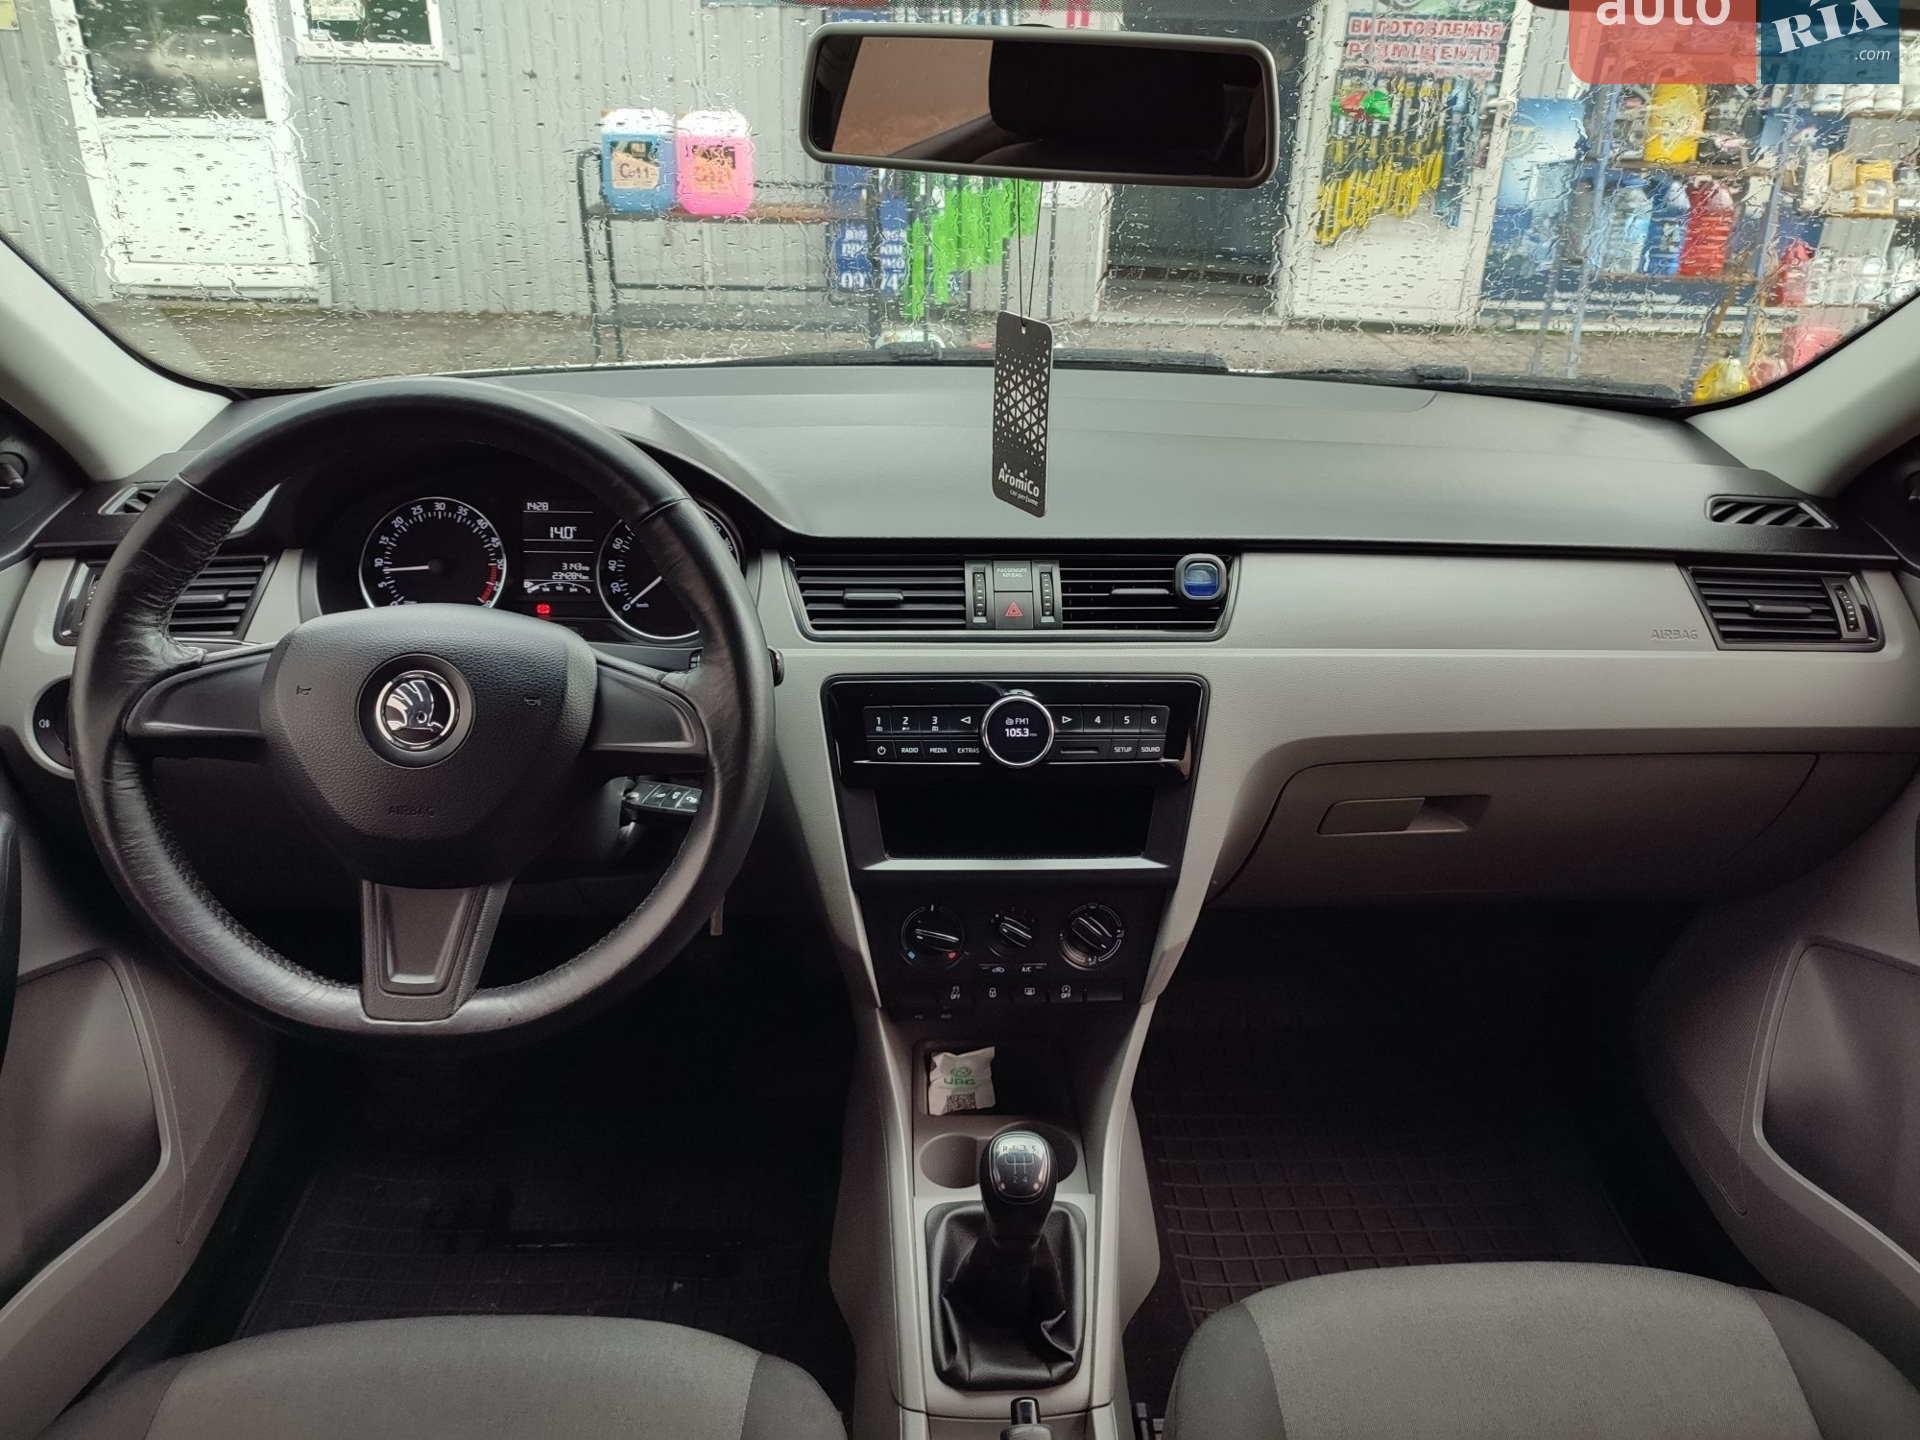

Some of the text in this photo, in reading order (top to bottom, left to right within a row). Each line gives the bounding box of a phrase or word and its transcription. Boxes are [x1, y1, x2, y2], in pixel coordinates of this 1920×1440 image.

[998, 466, 1040, 498] AromiCo
[411, 505, 424, 516] 25
[434, 502, 446, 511] 30
[457, 505, 469, 516] 35
[391, 516, 404, 528] 20
[476, 518, 489, 530] 40
[378, 535, 390, 546] 15
[490, 536, 501, 548] 45
[612, 537, 623, 550] 60
[374, 557, 384, 568] 10
[608, 559, 617, 572] 40
[610, 582, 621, 594] 20
[622, 603, 631, 611] 0
[1650, 629, 1699, 640] AIRBAG
[876, 716, 881, 725] 1
[902, 716, 909, 725] 2
[931, 716, 938, 725] 3
[1015, 717, 1029, 725] FM1
[1094, 716, 1101, 724] 4
[1124, 716, 1130, 725] 5
[1150, 716, 1157, 725] 6
[1005, 728, 1030, 738] 105.3
